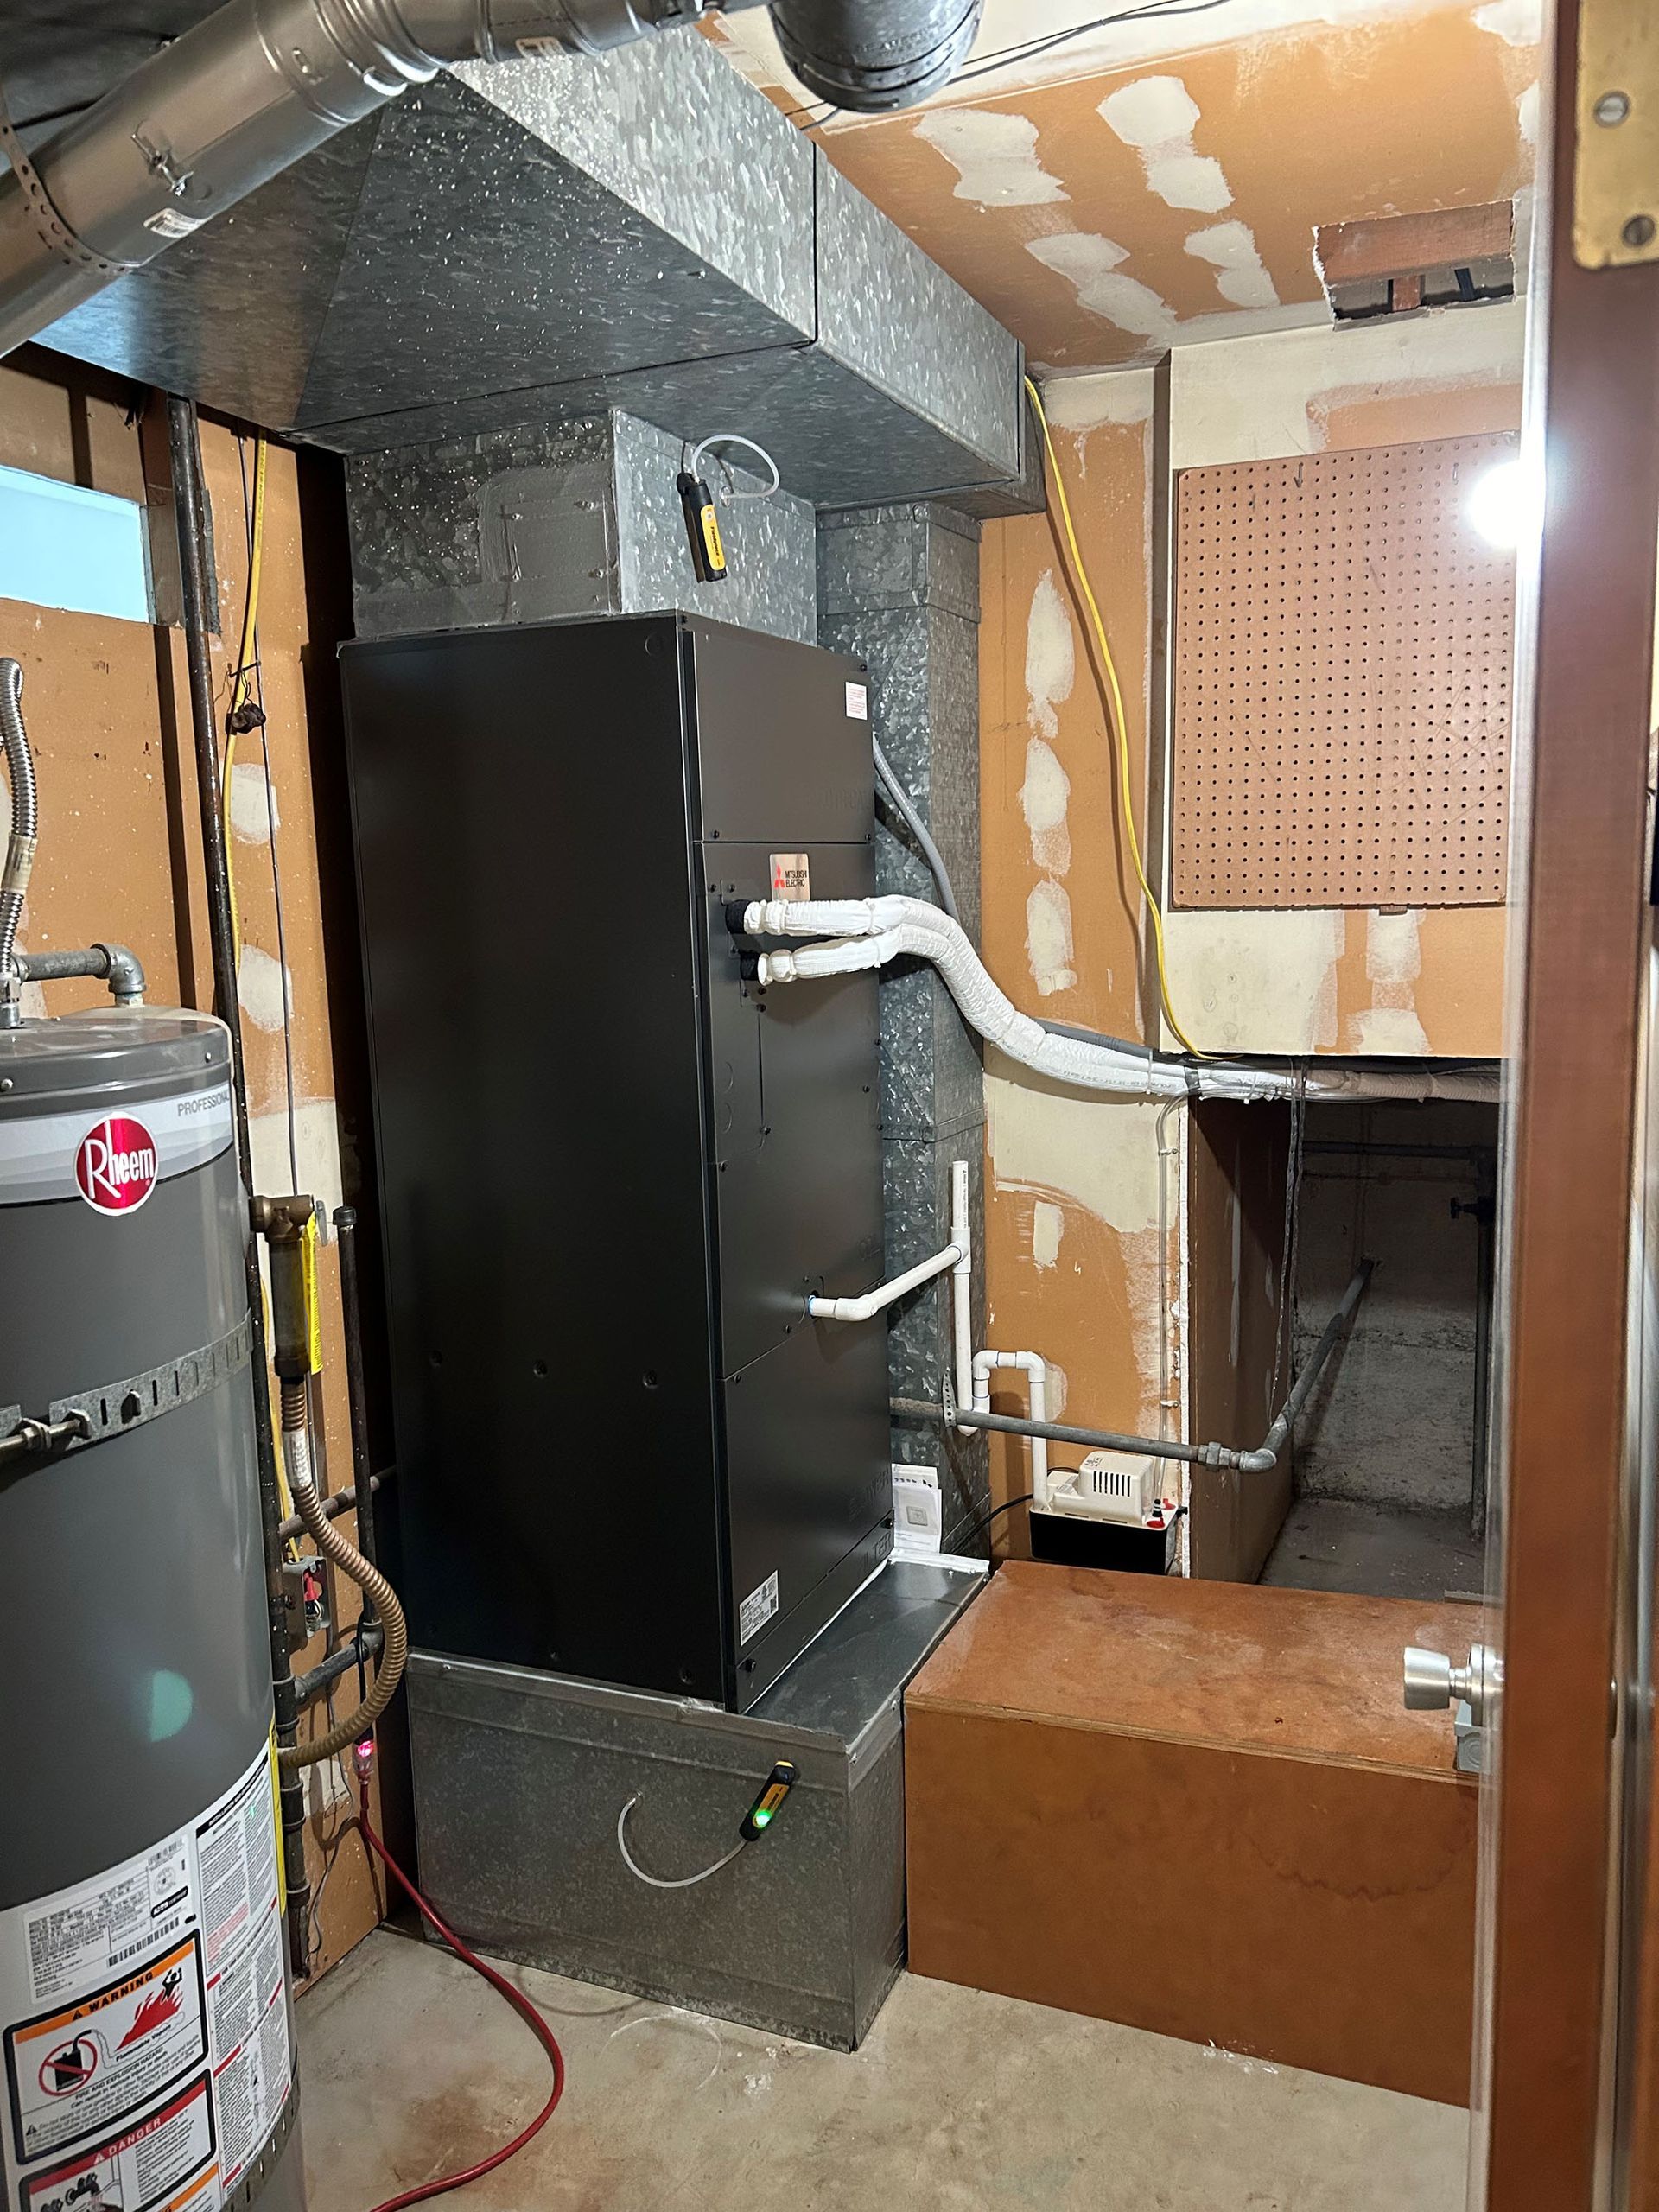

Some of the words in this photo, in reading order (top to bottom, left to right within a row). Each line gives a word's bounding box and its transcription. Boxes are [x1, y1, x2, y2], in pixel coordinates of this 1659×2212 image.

[785, 870, 807, 879] MITSUBISHI
[785, 879, 805, 887] ELECTRIC
[84, 1120, 154, 1199] Rheem
[89, 1972, 153, 2013] WARNING
[92, 2081, 105, 2092] AND
[106, 2063, 140, 2085] EXPLOSION
[140, 2046, 164, 2065] HAZARD
[117, 2039, 150, 2062] Flammable
[109, 2118, 161, 2156] DANGER
